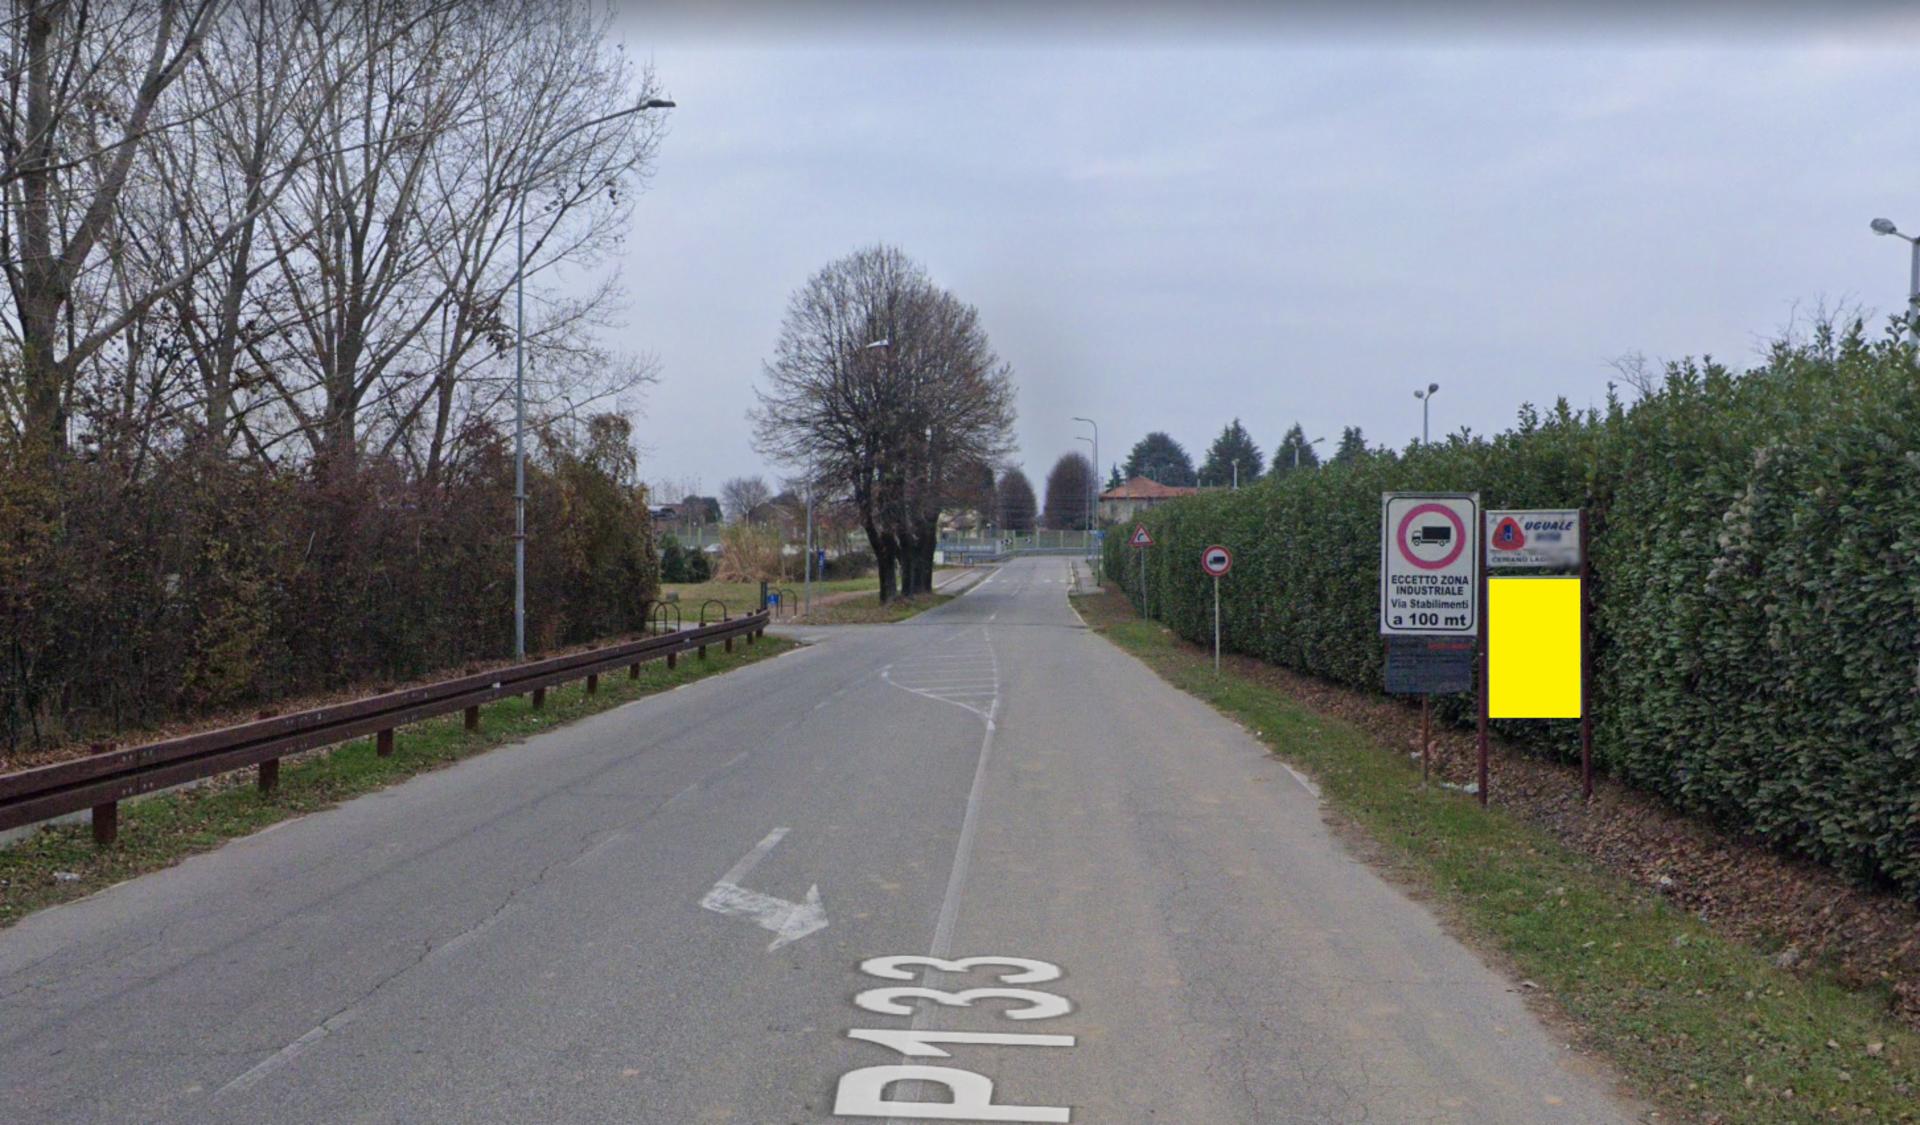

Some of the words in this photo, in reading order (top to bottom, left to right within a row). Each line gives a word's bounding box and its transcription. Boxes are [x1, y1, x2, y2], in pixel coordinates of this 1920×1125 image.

[1524, 521, 1574, 531] UGUALE
[1391, 575, 1438, 585] ECCETTO
[1441, 575, 1469, 585] ZONA
[1396, 586, 1464, 596] INDUSTRIALE
[1391, 598, 1407, 609] Via
[1410, 599, 1469, 609] Stabilimenti
[1393, 614, 1403, 625] a
[1409, 613, 1439, 626] 100
[1444, 614, 1467, 626] mt
